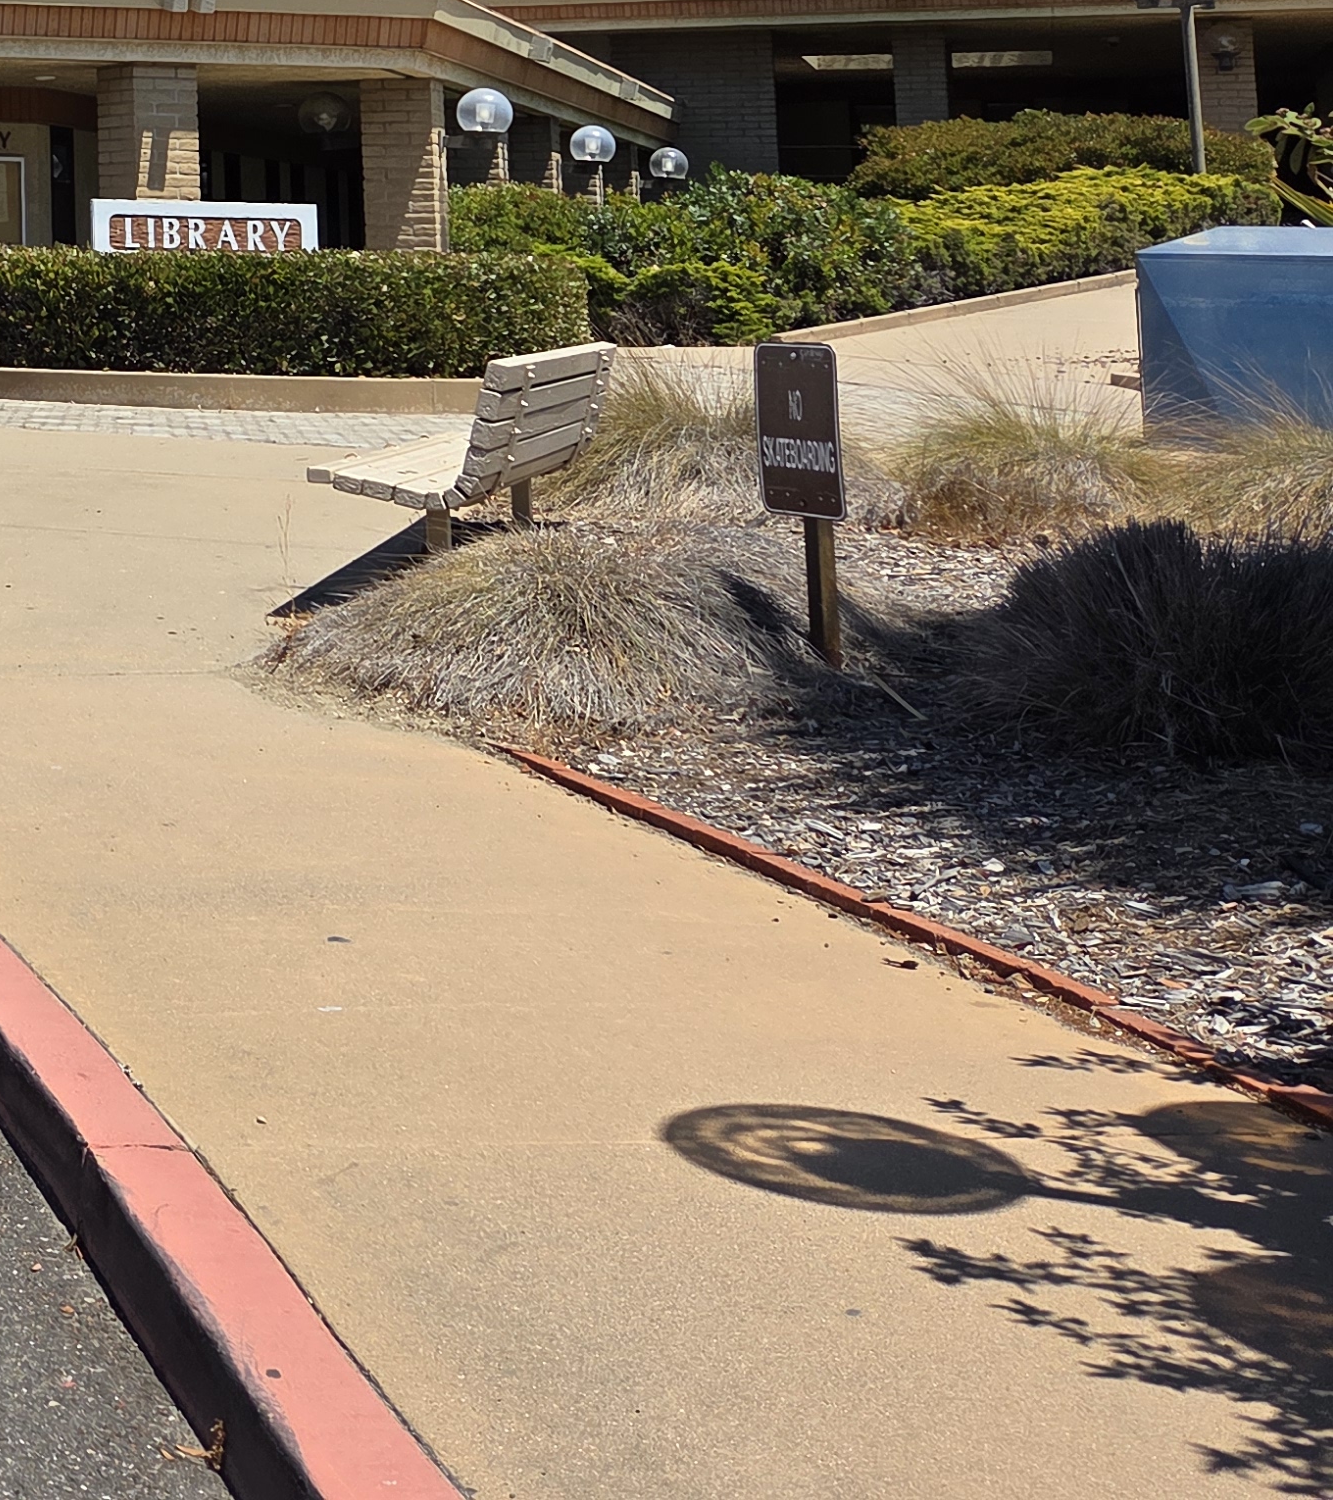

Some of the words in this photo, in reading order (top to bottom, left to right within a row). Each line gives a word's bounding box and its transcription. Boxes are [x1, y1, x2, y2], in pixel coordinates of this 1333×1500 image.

[123, 216, 292, 252] LIBRARY
[788, 389, 803, 421] NO
[762, 434, 836, 474] SKATEBOARDING
